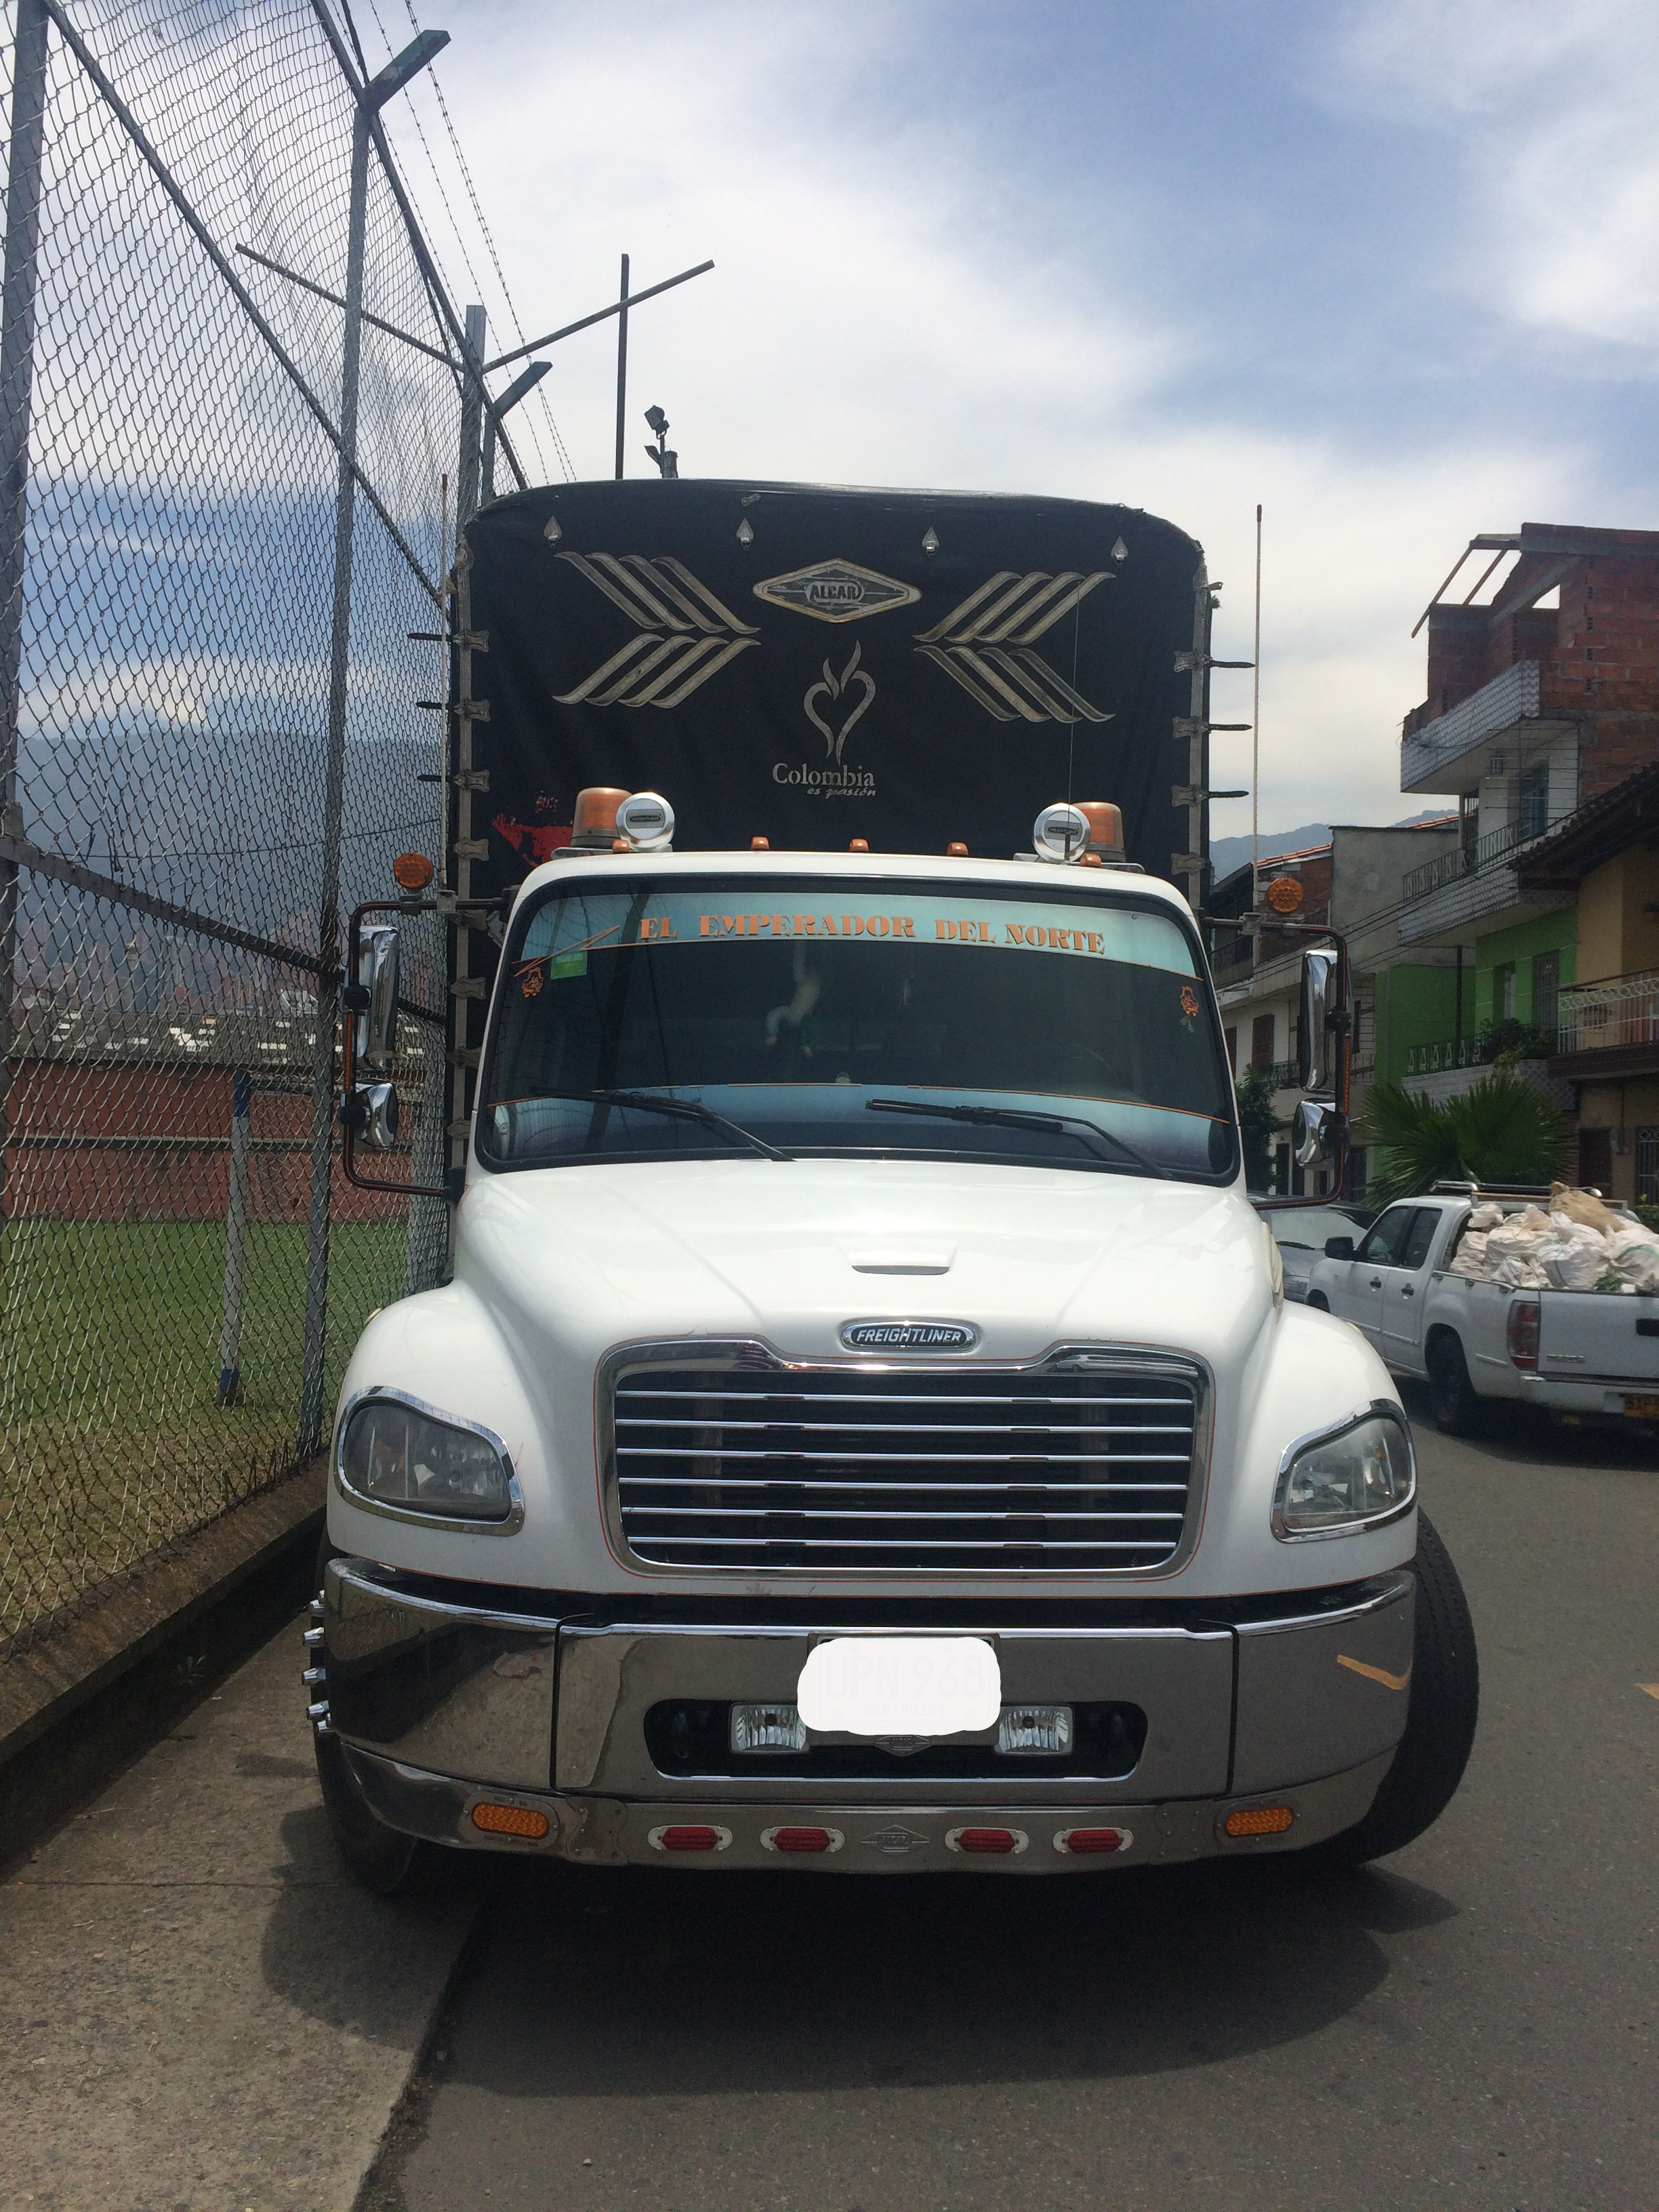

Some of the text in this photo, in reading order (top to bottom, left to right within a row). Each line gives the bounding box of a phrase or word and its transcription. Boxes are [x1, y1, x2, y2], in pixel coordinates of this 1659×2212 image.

[810, 584, 858, 600] ALCAR
[773, 762, 876, 787] Colombia
[640, 914, 1105, 956] EL EMPERADOR DEL NORTE
[856, 1328, 962, 1343] FREIGHTLINER
